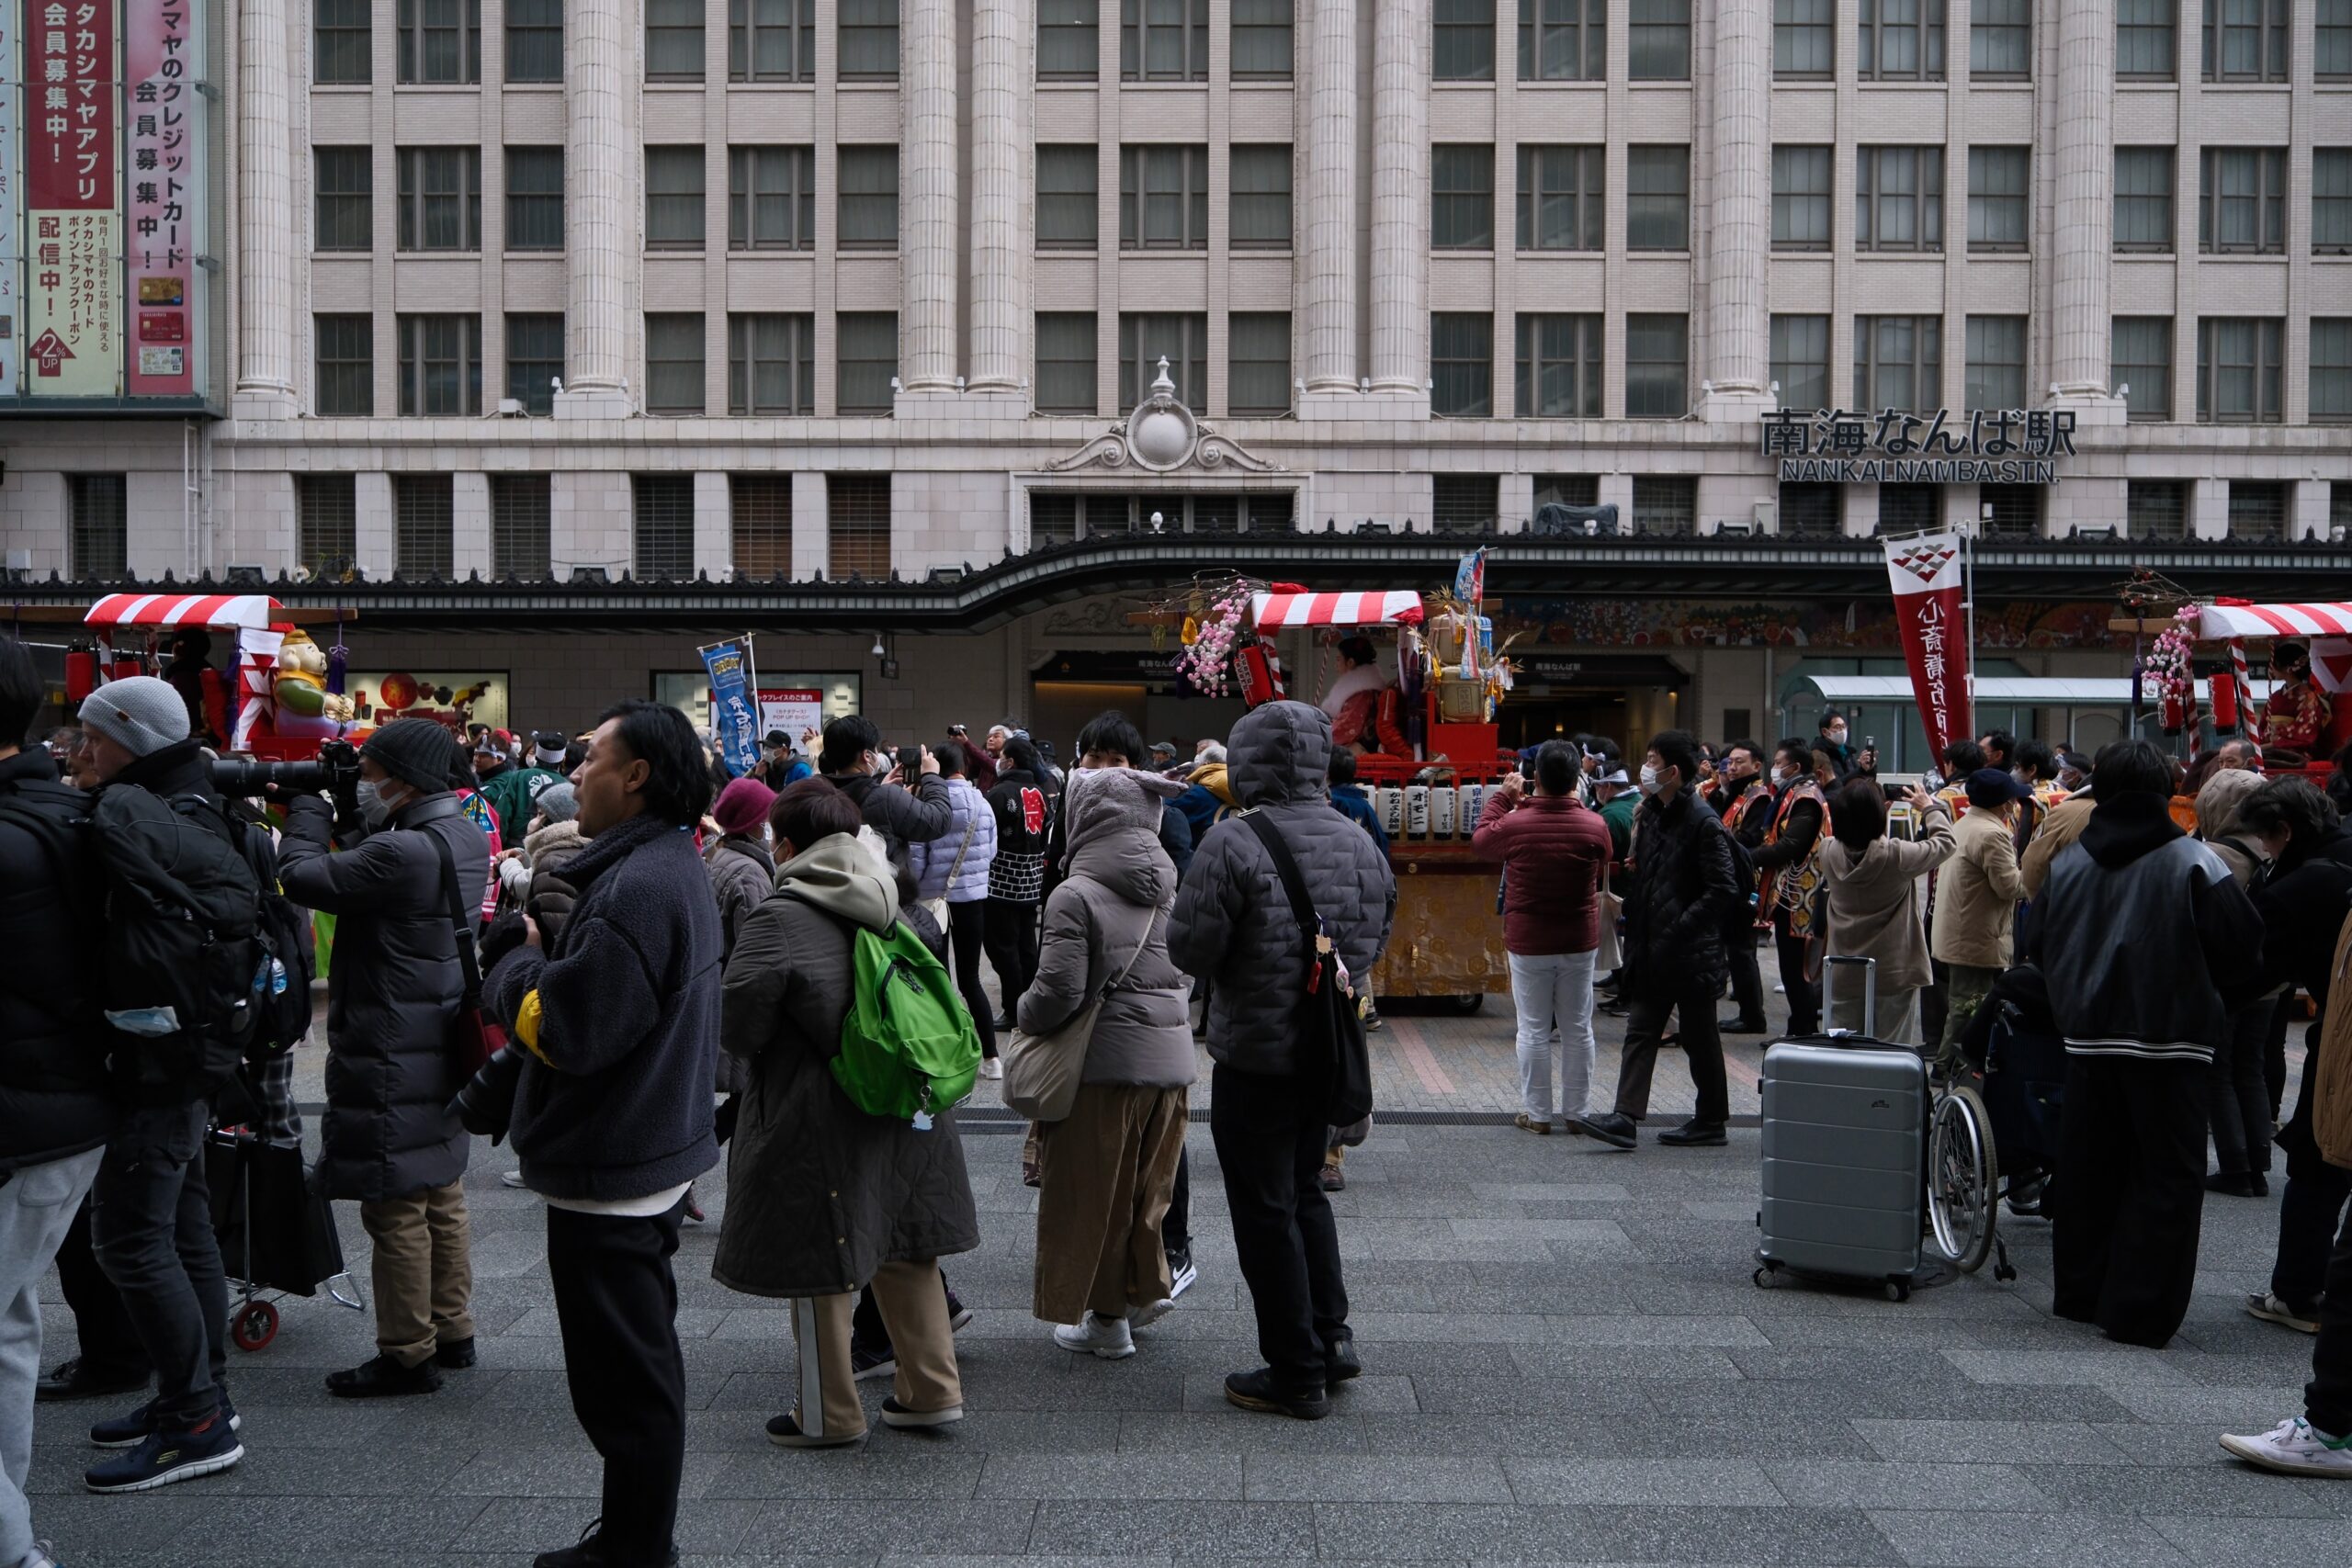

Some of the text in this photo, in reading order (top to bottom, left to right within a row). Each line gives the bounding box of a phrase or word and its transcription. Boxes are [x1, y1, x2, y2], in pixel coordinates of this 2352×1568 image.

[44, 3, 68, 164] 会員募集中！
[75, 4, 98, 200] タカシマヤアプリ
[135, 80, 158, 269] 会員募集中！
[38, 216, 61, 317] 配信中！
[68, 216, 81, 345] ポイントアップクーポン
[83, 216, 96, 329] タカシマヤのカード
[98, 216, 109, 353] 毎月1回お好きな時に使える
[42, 359, 58, 368] UP
[1759, 406, 2078, 458] 南海なんば駅
[1780, 459, 2063, 483] NANKAI NAMBA STN.
[1535, 662, 1581, 671] 南海なんば駅
[1412, 792, 1425, 825] オモニ
